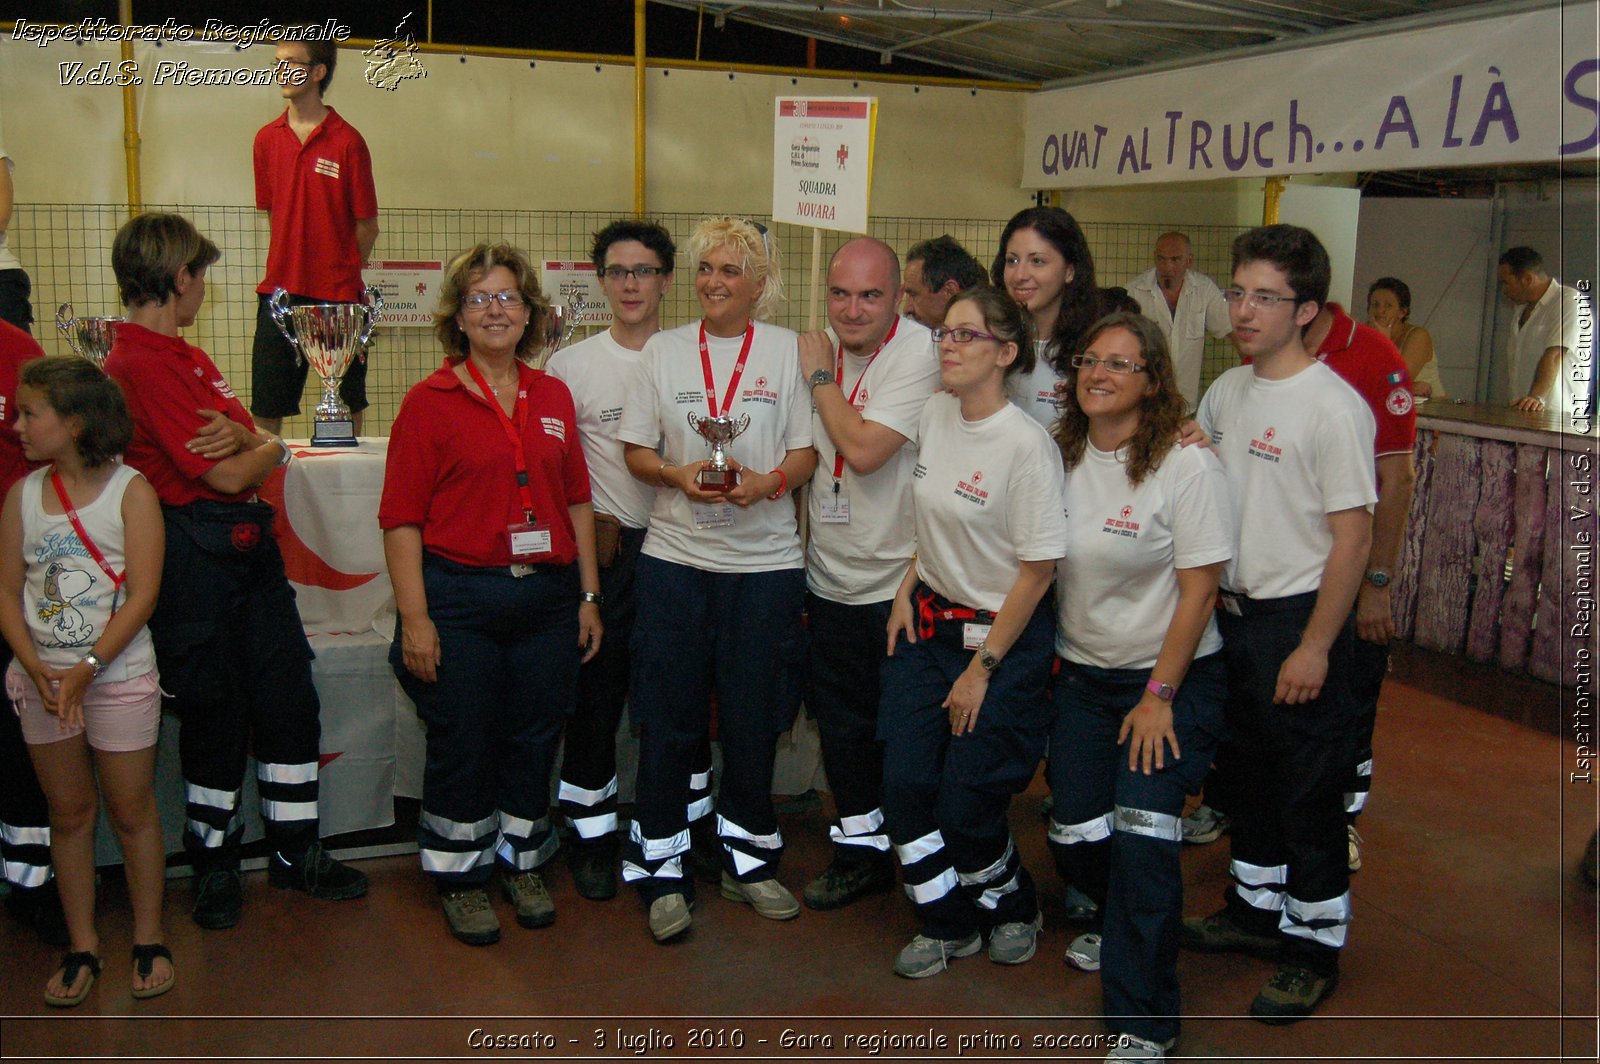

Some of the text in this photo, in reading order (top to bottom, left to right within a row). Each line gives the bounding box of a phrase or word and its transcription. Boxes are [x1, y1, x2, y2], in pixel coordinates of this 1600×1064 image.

[1042, 124, 1108, 175] QUAT
[1117, 126, 1152, 174] AL
[798, 180, 836, 195] SQUADRA
[797, 202, 835, 220] NOVARA
[383, 302, 417, 310] QUADRA
